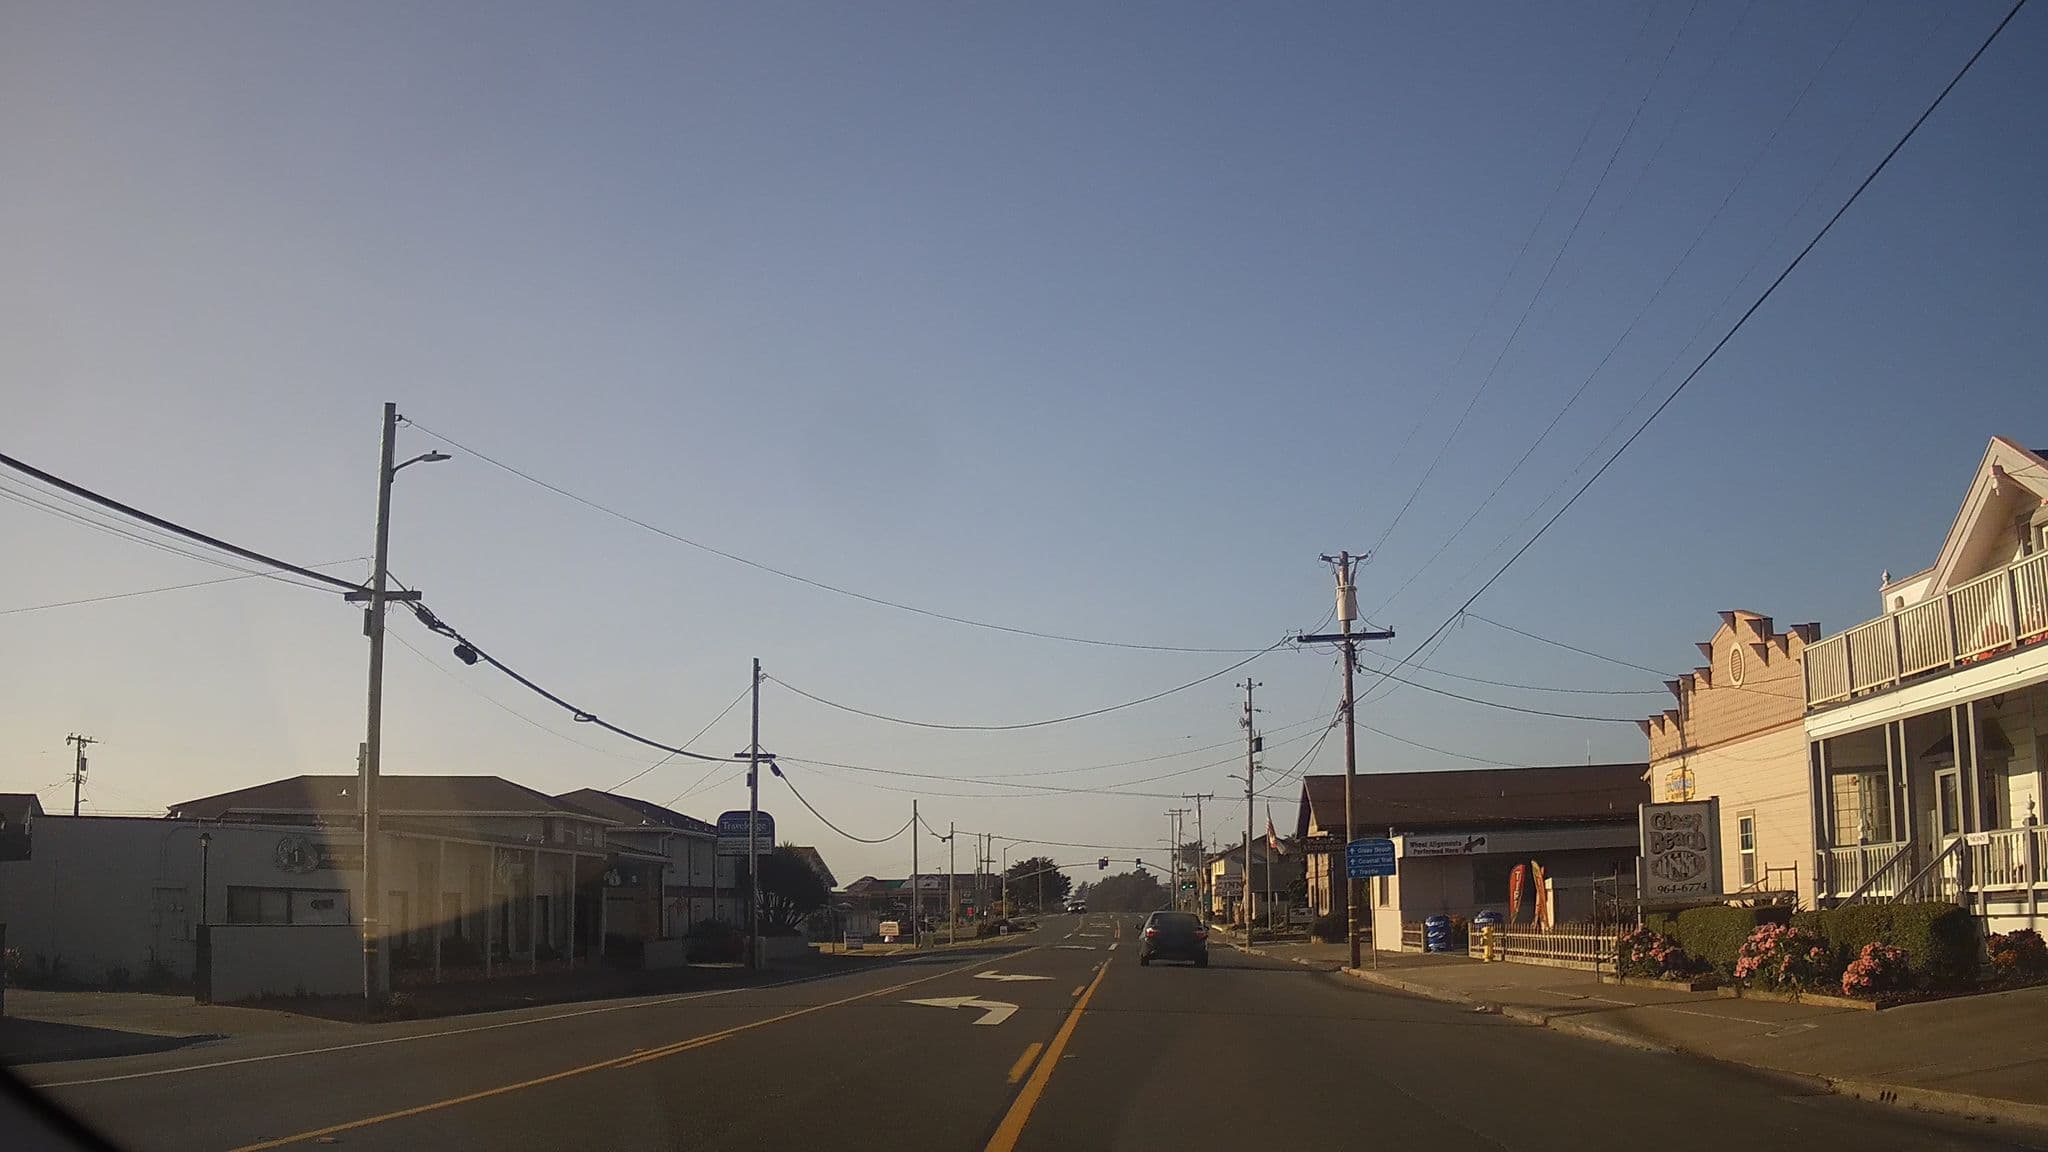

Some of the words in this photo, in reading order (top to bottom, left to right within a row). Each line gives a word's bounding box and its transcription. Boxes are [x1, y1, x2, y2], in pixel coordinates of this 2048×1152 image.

[722, 821, 767, 833] Traveloge
[1650, 811, 1703, 831] Glass
[1650, 830, 1708, 854] Beach
[1658, 852, 1698, 878] INN
[1657, 882, 1708, 894] 964-6774
